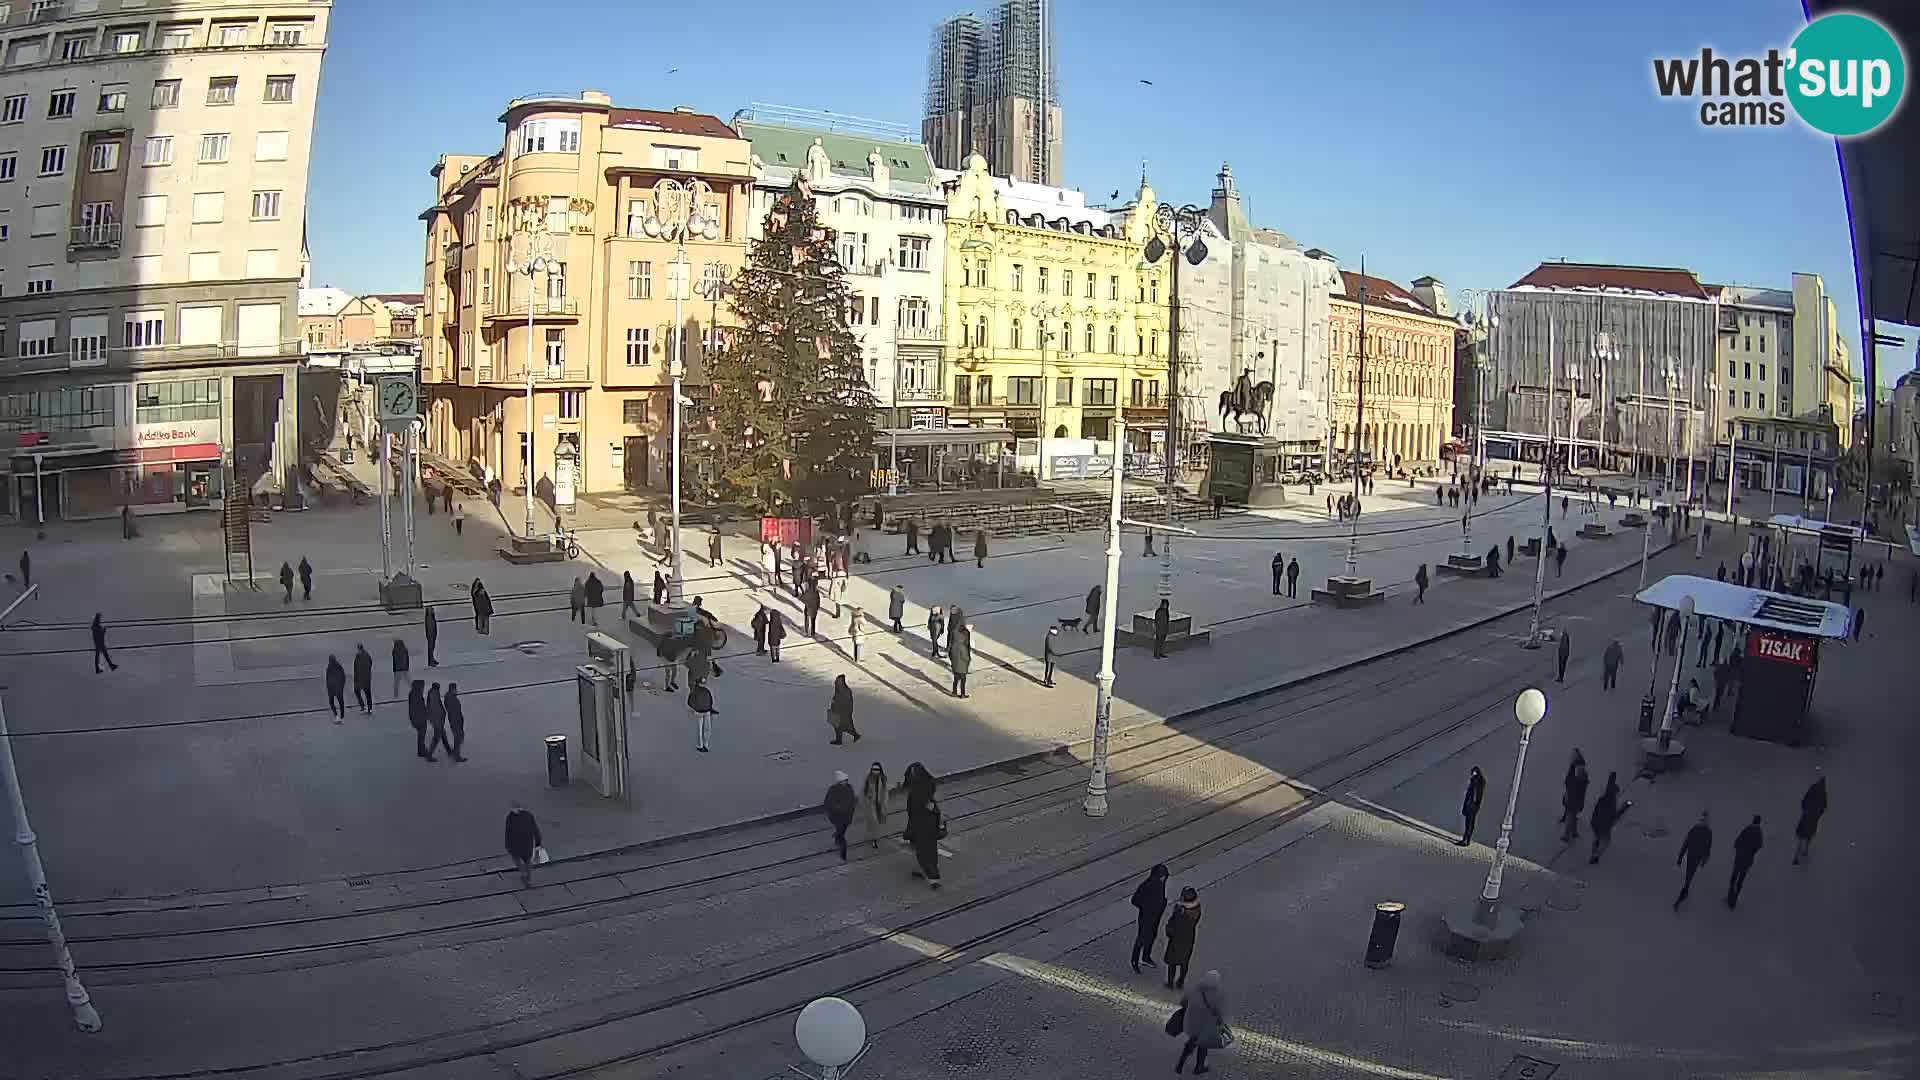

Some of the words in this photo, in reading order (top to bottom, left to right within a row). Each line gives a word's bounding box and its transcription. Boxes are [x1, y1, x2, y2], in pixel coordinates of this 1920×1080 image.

[137, 430, 170, 442] Addiko
[172, 429, 196, 439] Bank
[1760, 637, 1802, 660] TISAK
